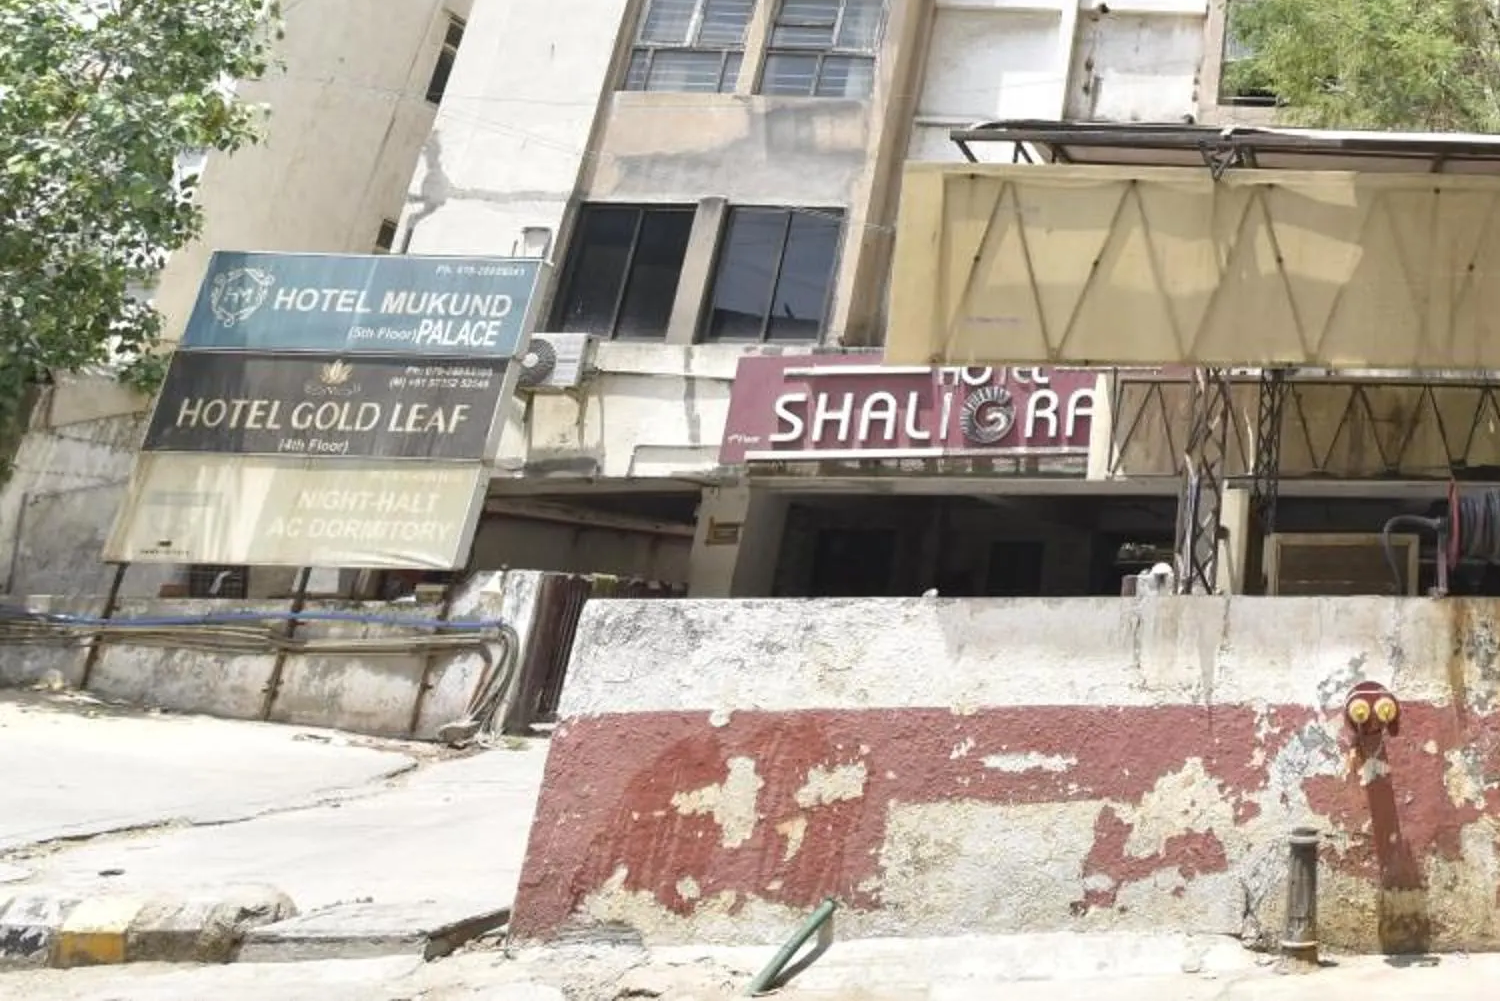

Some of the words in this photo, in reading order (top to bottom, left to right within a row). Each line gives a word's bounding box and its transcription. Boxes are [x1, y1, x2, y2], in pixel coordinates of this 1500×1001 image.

[273, 287, 372, 314] HOTEL
[379, 289, 513, 318] MUKUND
[415, 318, 502, 347] PALACE
[176, 397, 282, 430] HOTEL
[290, 401, 382, 432] GOLD
[387, 401, 472, 434] LEAF
[296, 488, 441, 514] NIGHT-HALT
[267, 516, 302, 539] AC
[308, 518, 456, 543] DORMITORY
